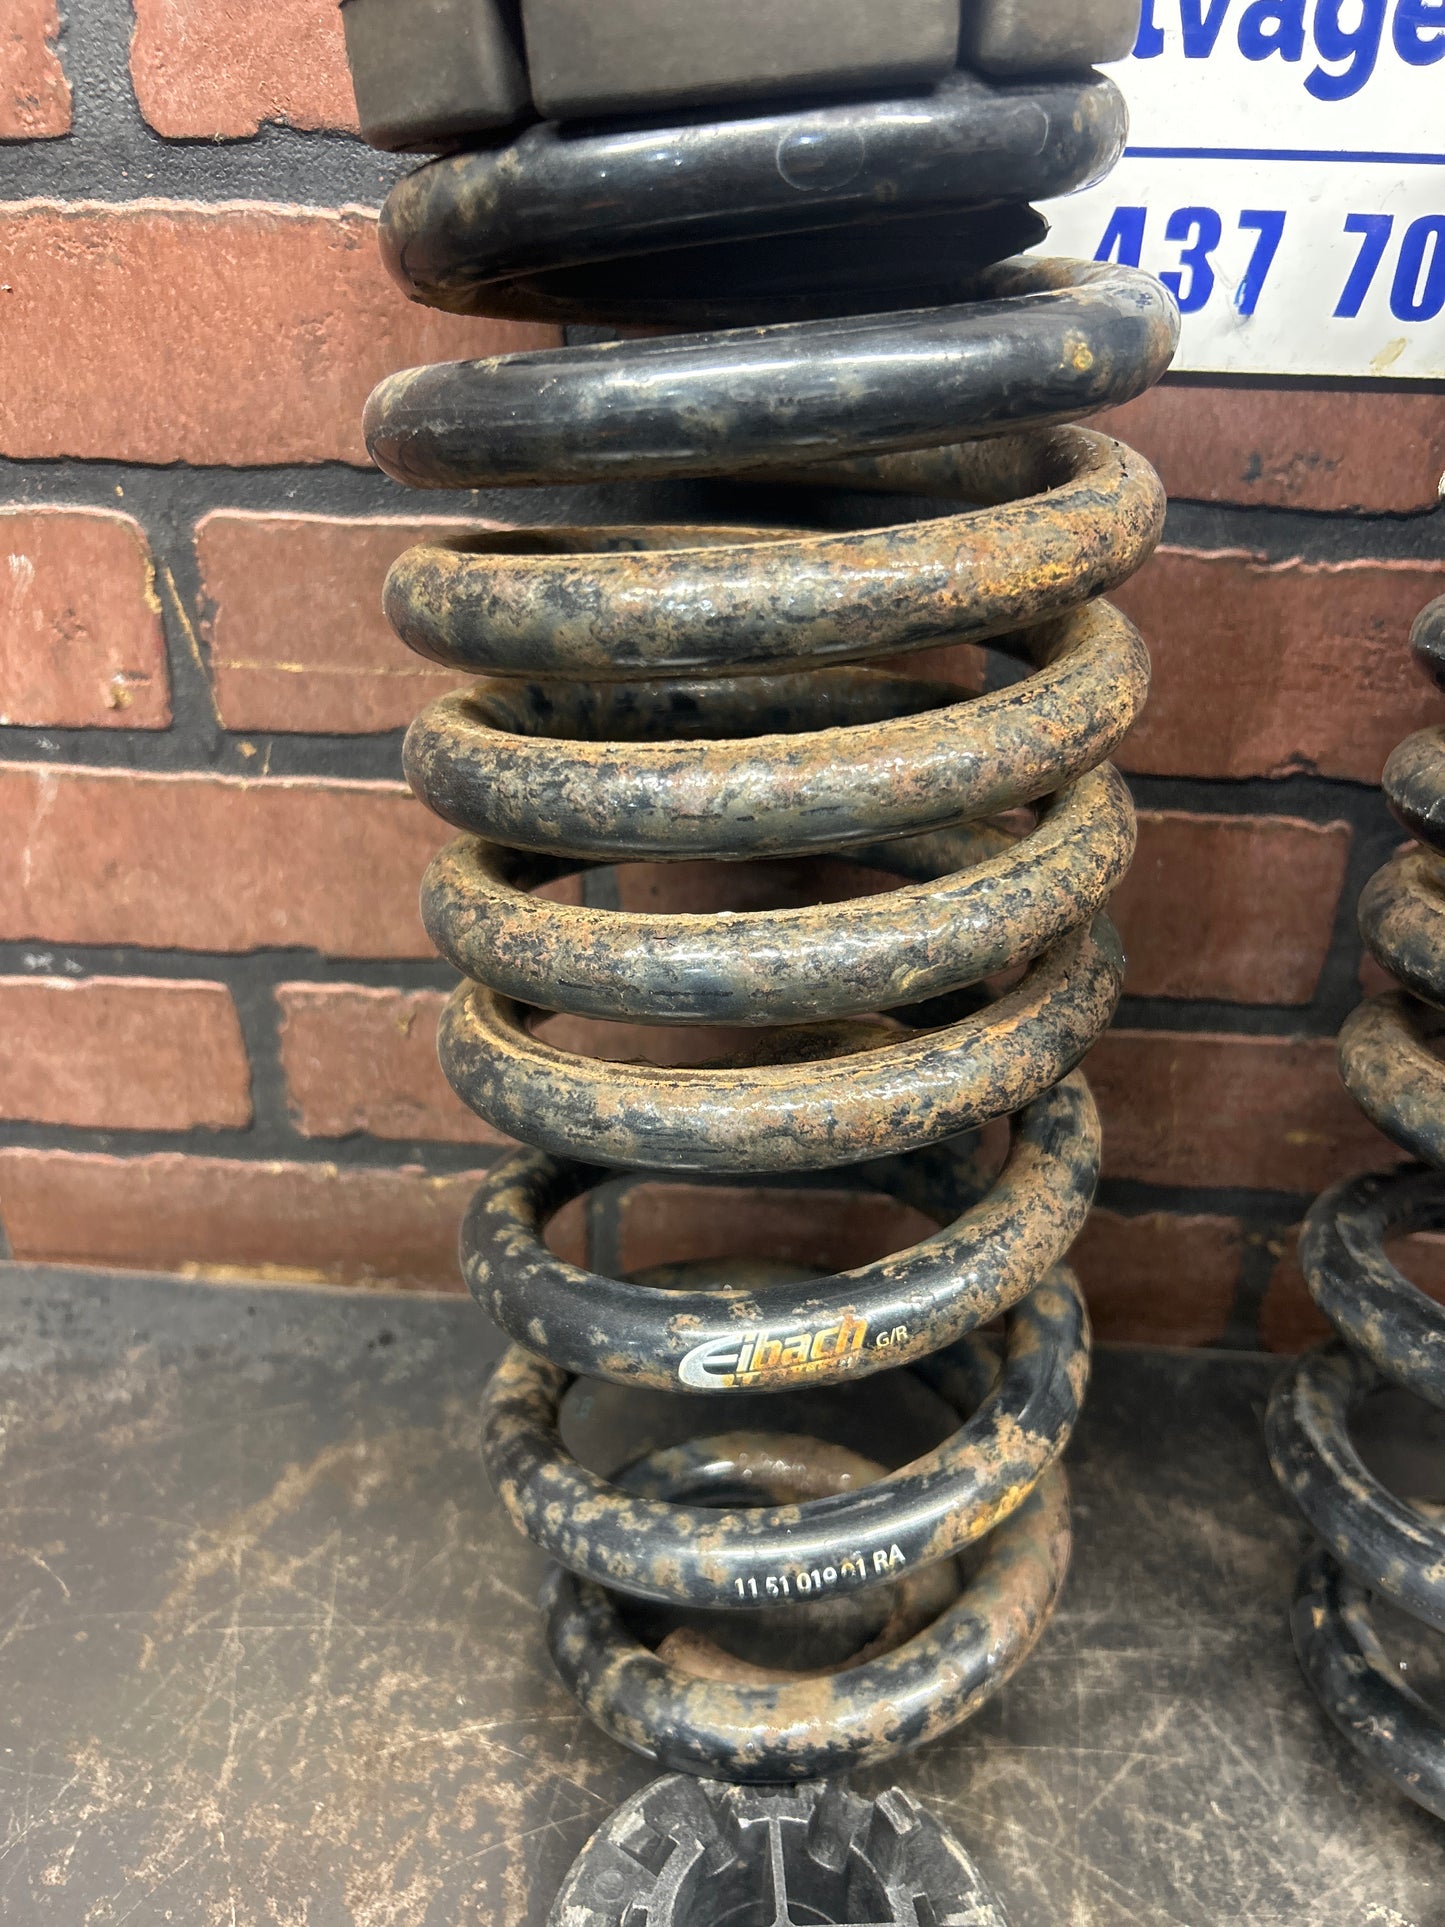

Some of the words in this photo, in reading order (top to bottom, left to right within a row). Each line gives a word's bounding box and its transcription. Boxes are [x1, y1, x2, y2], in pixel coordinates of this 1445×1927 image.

[1333, 213, 1445, 323] 70
[678, 1314, 868, 1388] Eibach
[875, 1325, 909, 1348] G/R
[734, 1577, 758, 1599] 11
[872, 1543, 907, 1575] RA
